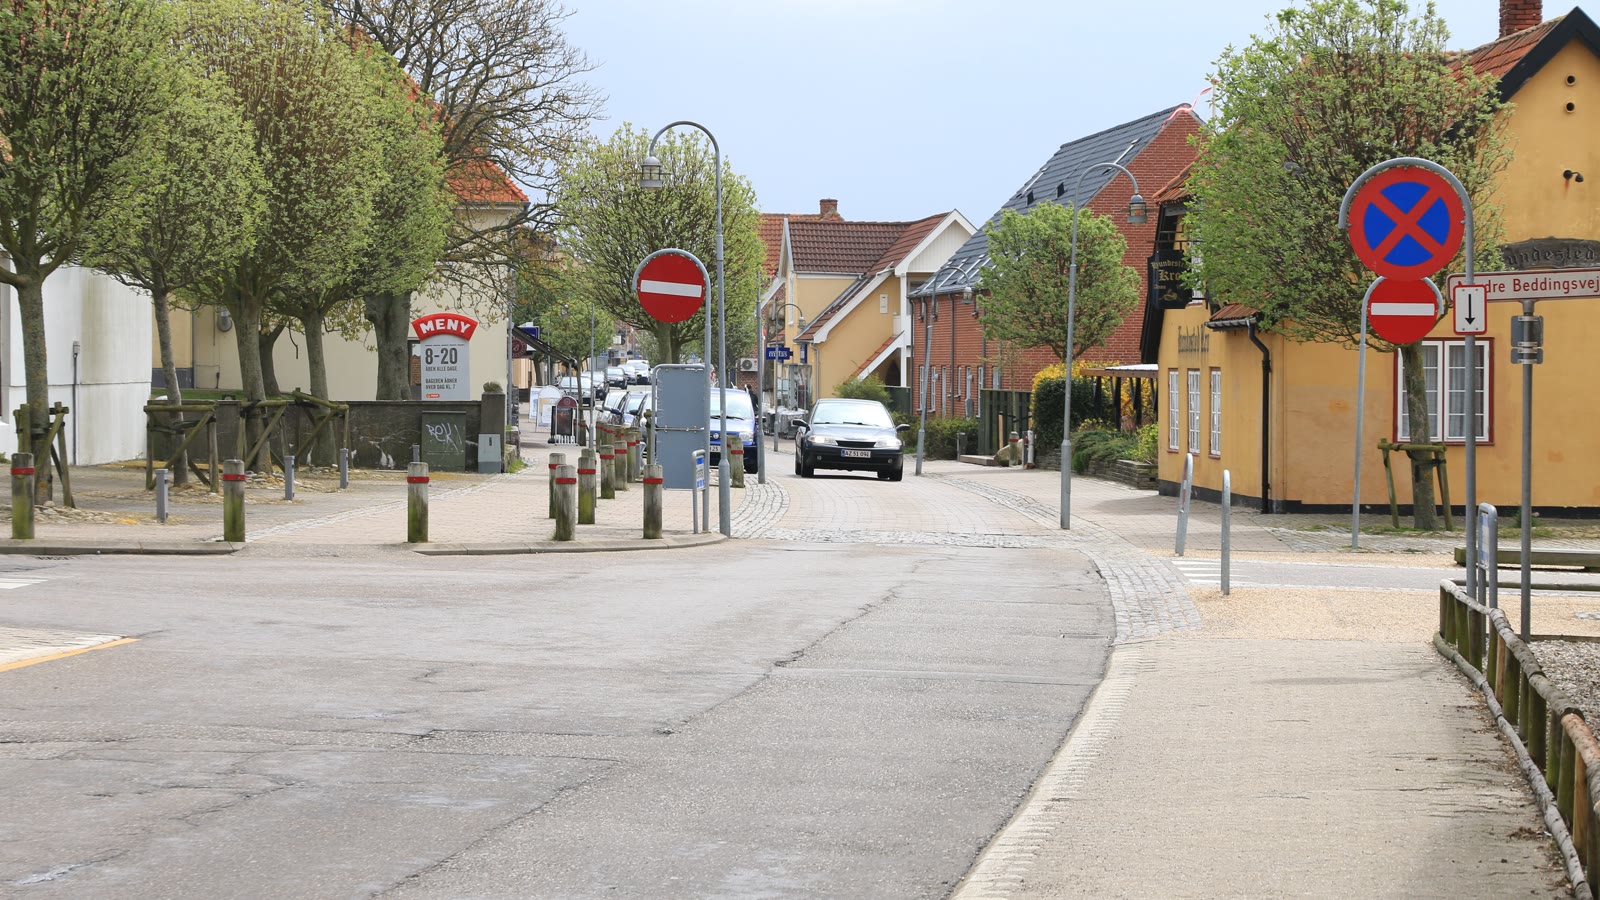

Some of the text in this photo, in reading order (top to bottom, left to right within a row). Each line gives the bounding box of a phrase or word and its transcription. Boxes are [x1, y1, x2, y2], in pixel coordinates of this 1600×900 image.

[1508, 246, 1595, 265] undested
[1512, 276, 1600, 295] Beddingsvej
[419, 318, 472, 335] MENY
[425, 347, 458, 365] 8-20
